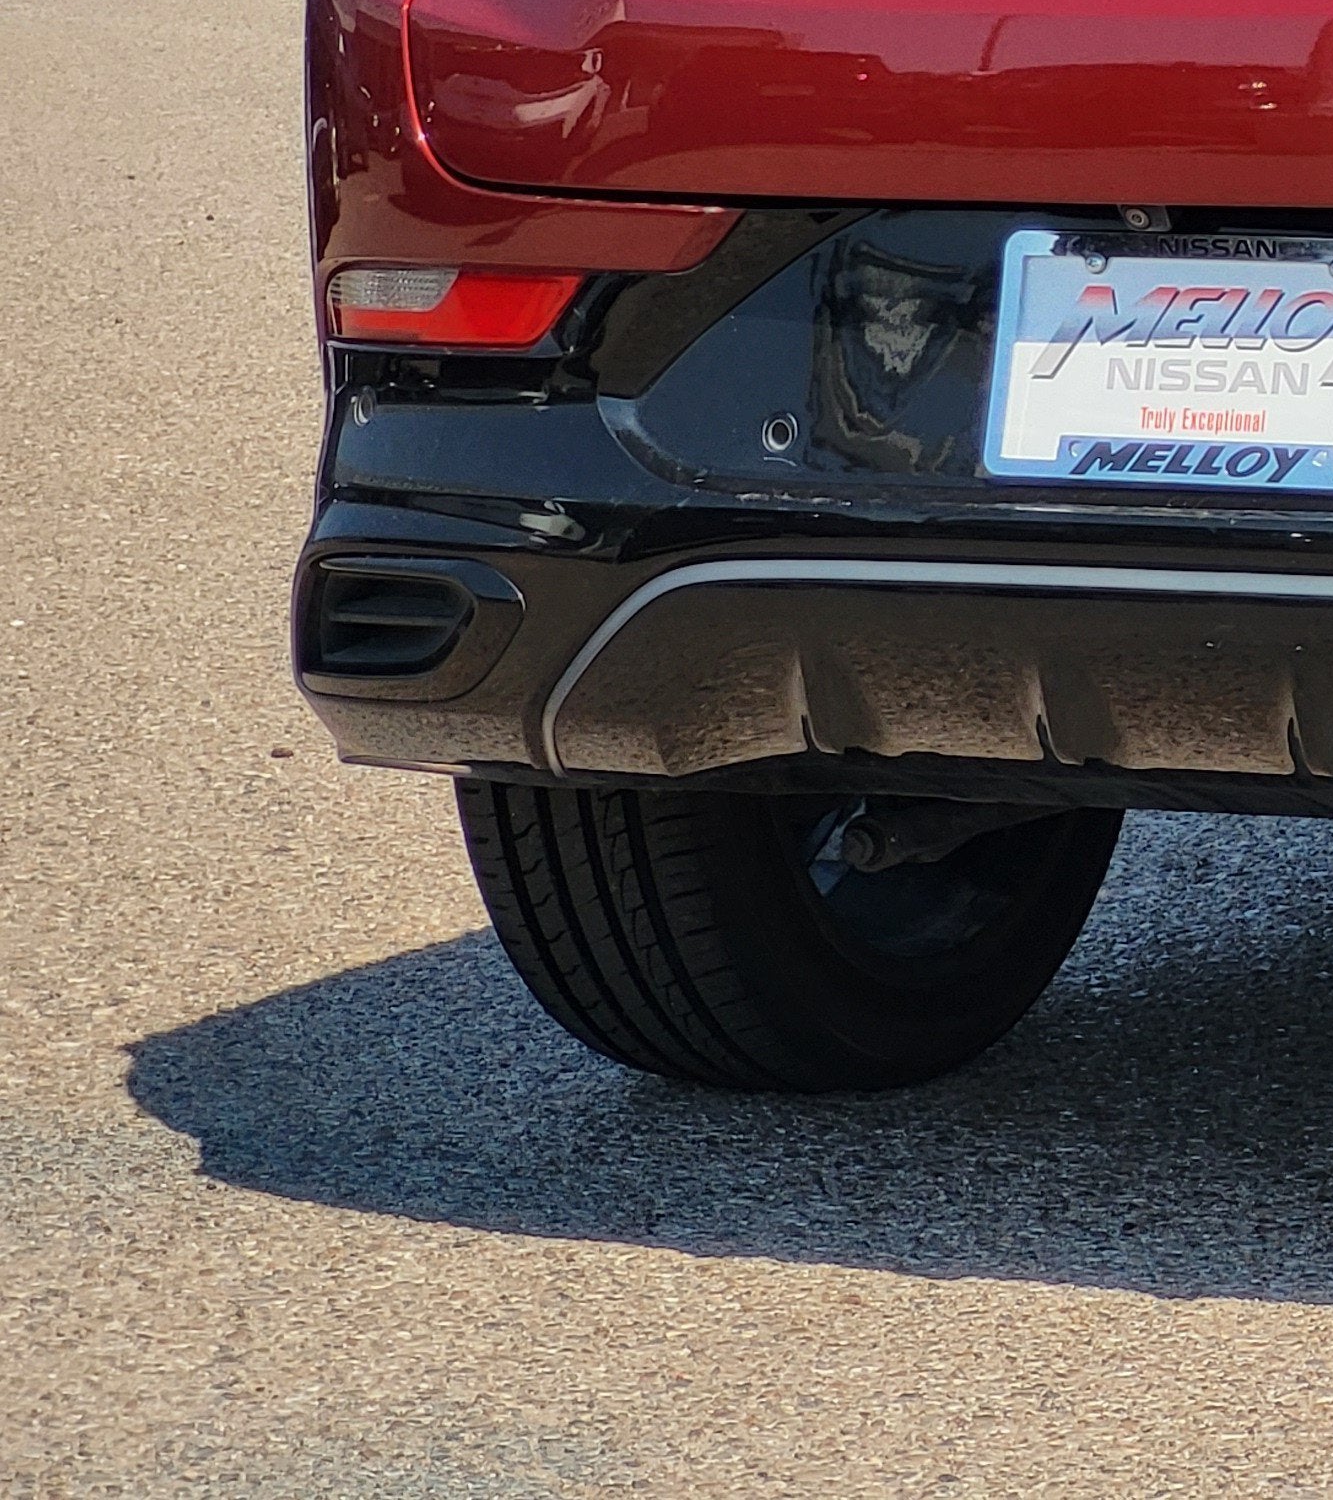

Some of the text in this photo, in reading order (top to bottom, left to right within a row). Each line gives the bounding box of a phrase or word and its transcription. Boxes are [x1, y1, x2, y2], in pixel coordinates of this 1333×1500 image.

[1155, 236, 1278, 260] NISSAN
[1105, 358, 1310, 396] NISSAN
[1140, 406, 1266, 434] Truly Exceptional
[1070, 441, 1312, 484] MELLOY
